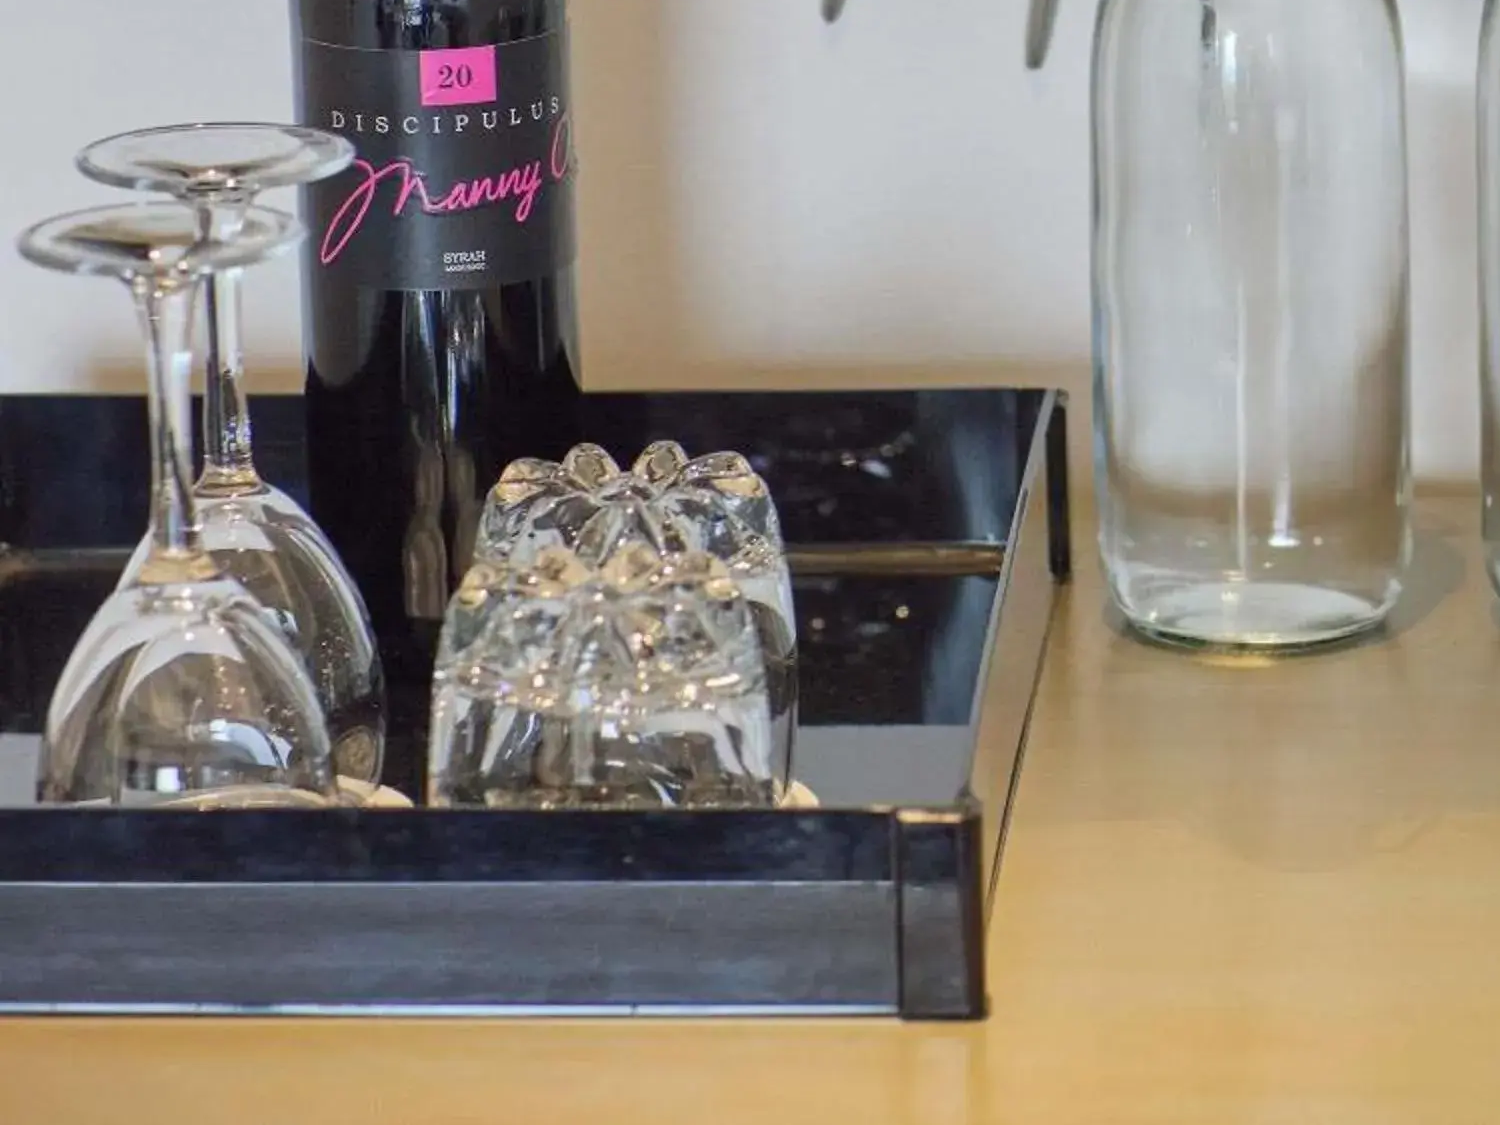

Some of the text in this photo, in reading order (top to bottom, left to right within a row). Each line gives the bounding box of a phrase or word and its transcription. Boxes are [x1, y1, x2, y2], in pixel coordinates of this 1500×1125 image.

[437, 63, 473, 90] 20
[331, 96, 560, 135] DISCIPULUS
[320, 155, 544, 265] Manny
[442, 250, 486, 264] SYRAH
